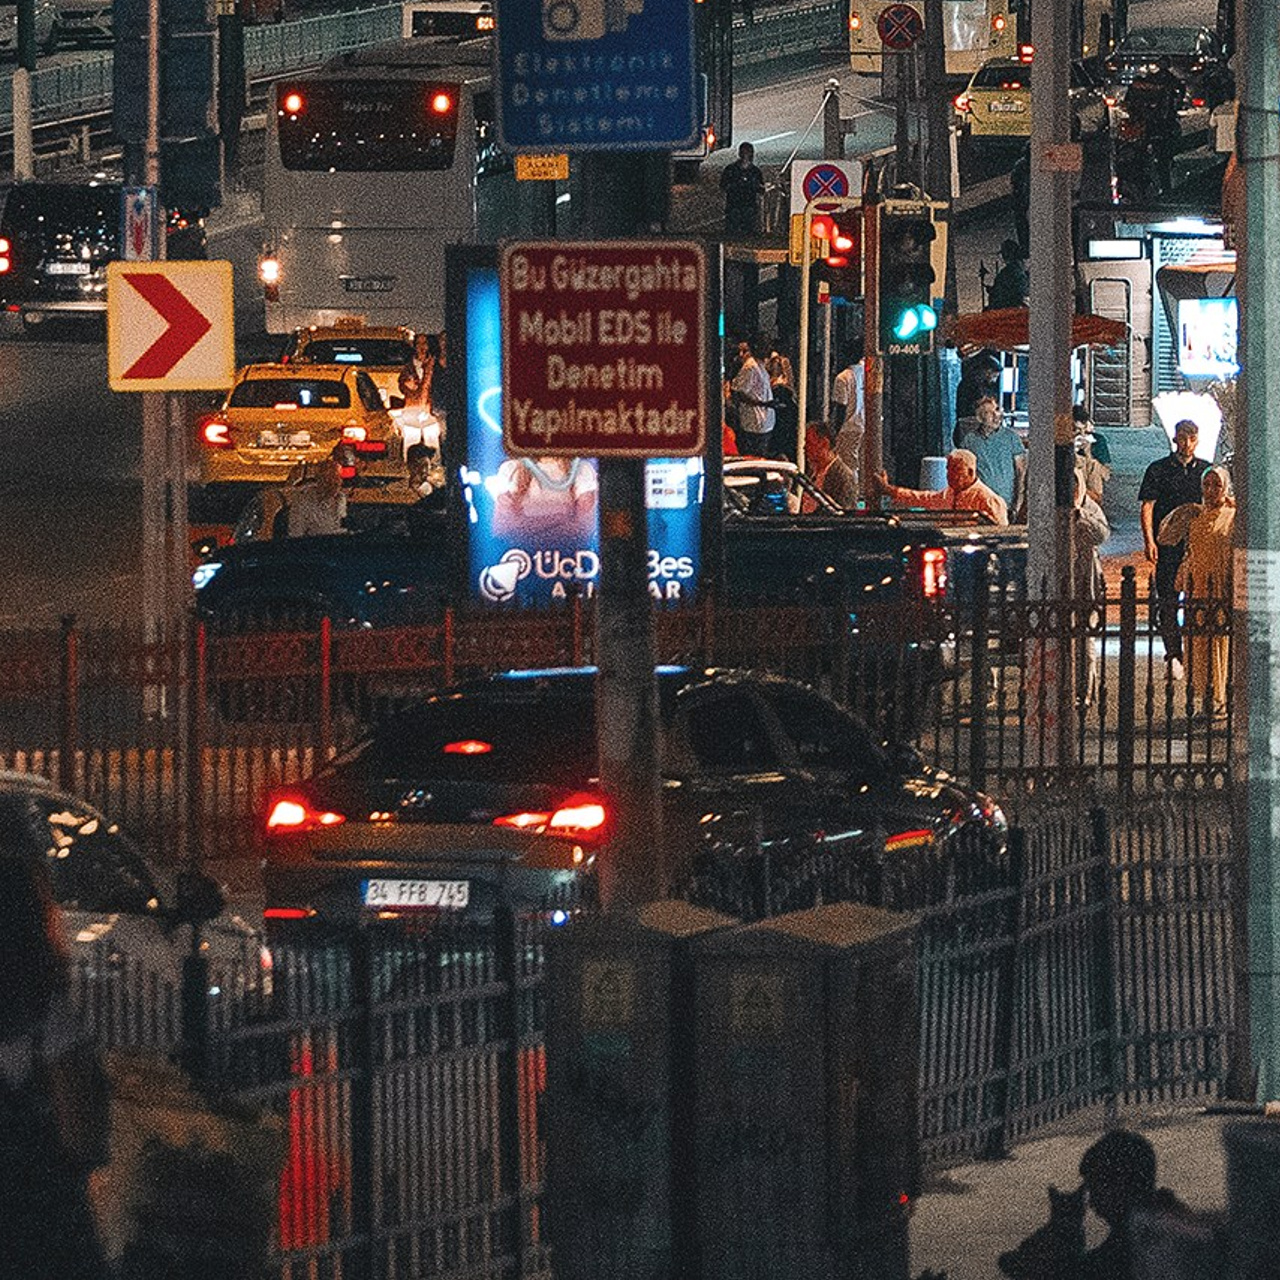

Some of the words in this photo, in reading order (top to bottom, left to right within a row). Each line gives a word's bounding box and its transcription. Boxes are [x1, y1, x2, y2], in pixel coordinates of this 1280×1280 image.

[511, 254, 546, 291] Bu
[520, 309, 592, 345] Mobil
[598, 309, 652, 345] EDS
[657, 310, 688, 345] ile
[547, 354, 664, 391] Denetim
[369, 882, 388, 901] 34
